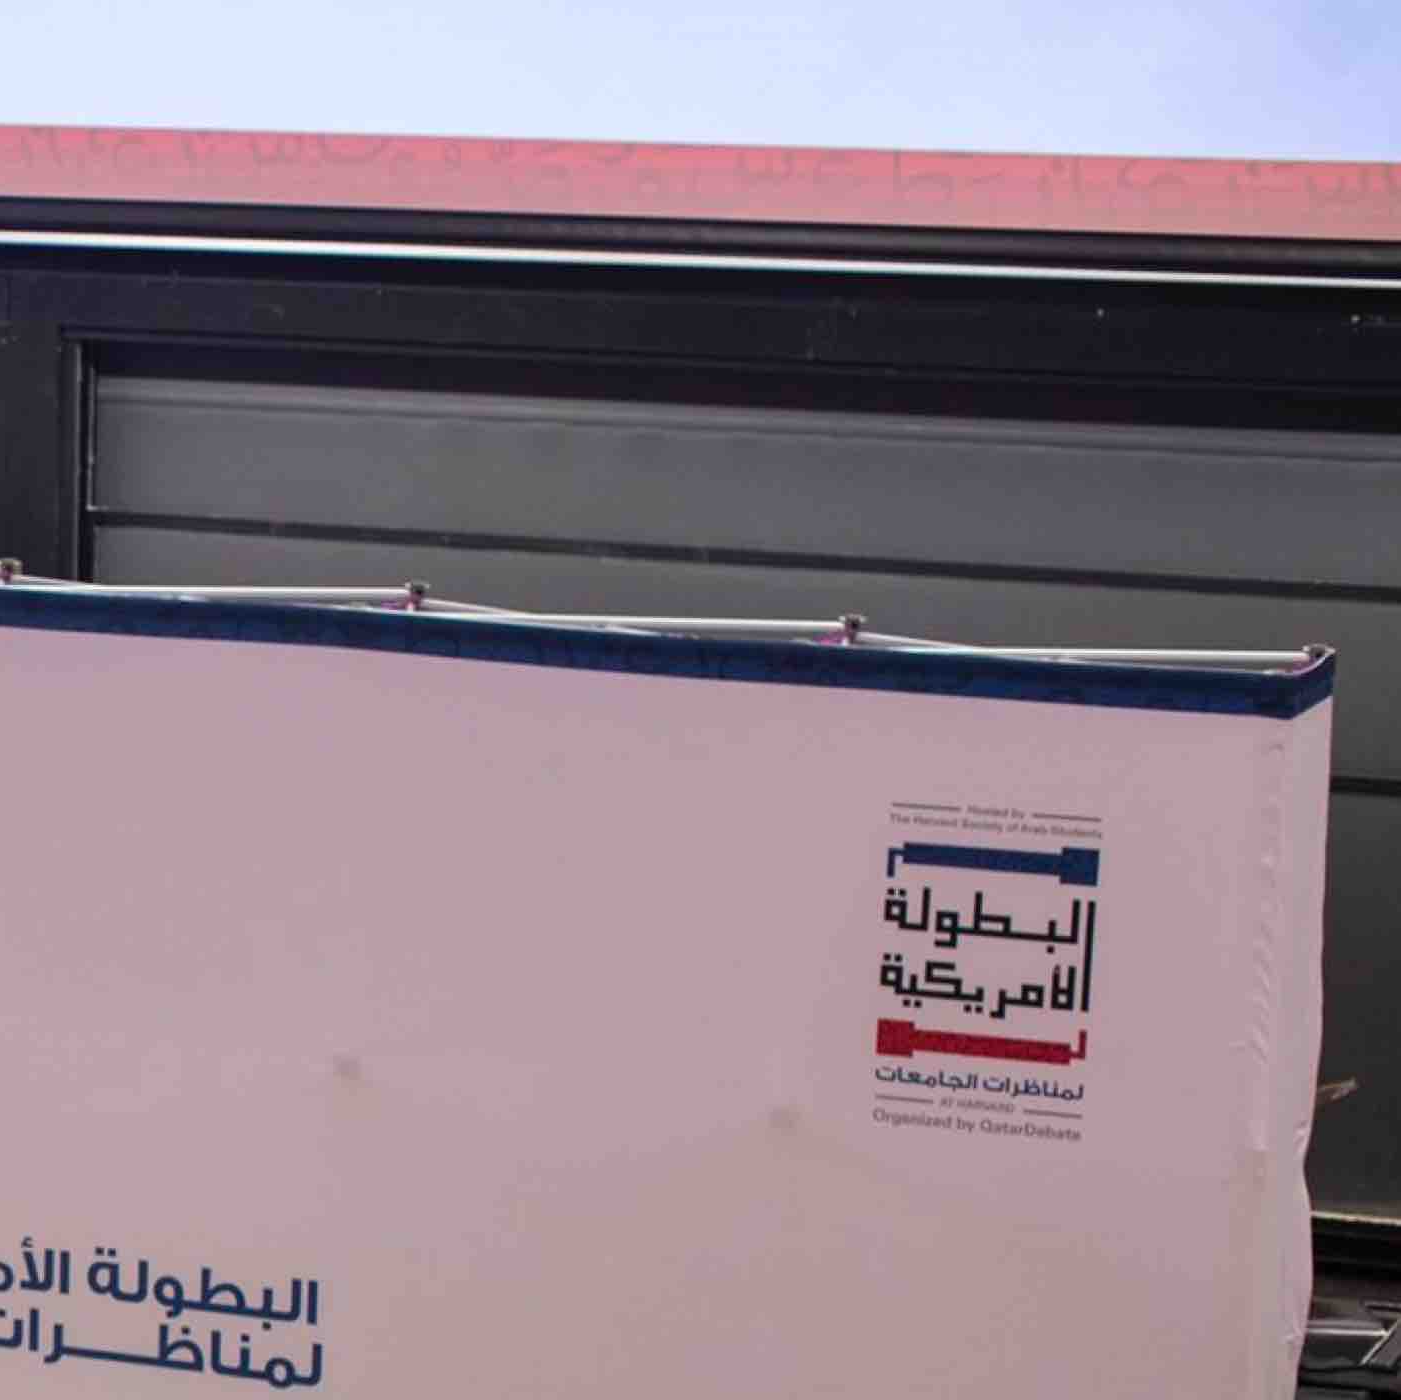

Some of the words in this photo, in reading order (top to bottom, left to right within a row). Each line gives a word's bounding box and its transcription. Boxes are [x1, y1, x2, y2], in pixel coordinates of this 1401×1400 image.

[883, 886, 1096, 955] البطولة
[875, 1065, 979, 1092] الجامعات
[982, 1075, 1085, 1103] لمناظرات
[872, 1107, 952, 1130] Organized
[956, 1115, 976, 1132] by
[980, 1118, 1083, 1142] QatarDebate
[87, 1246, 319, 1331] البطولة
